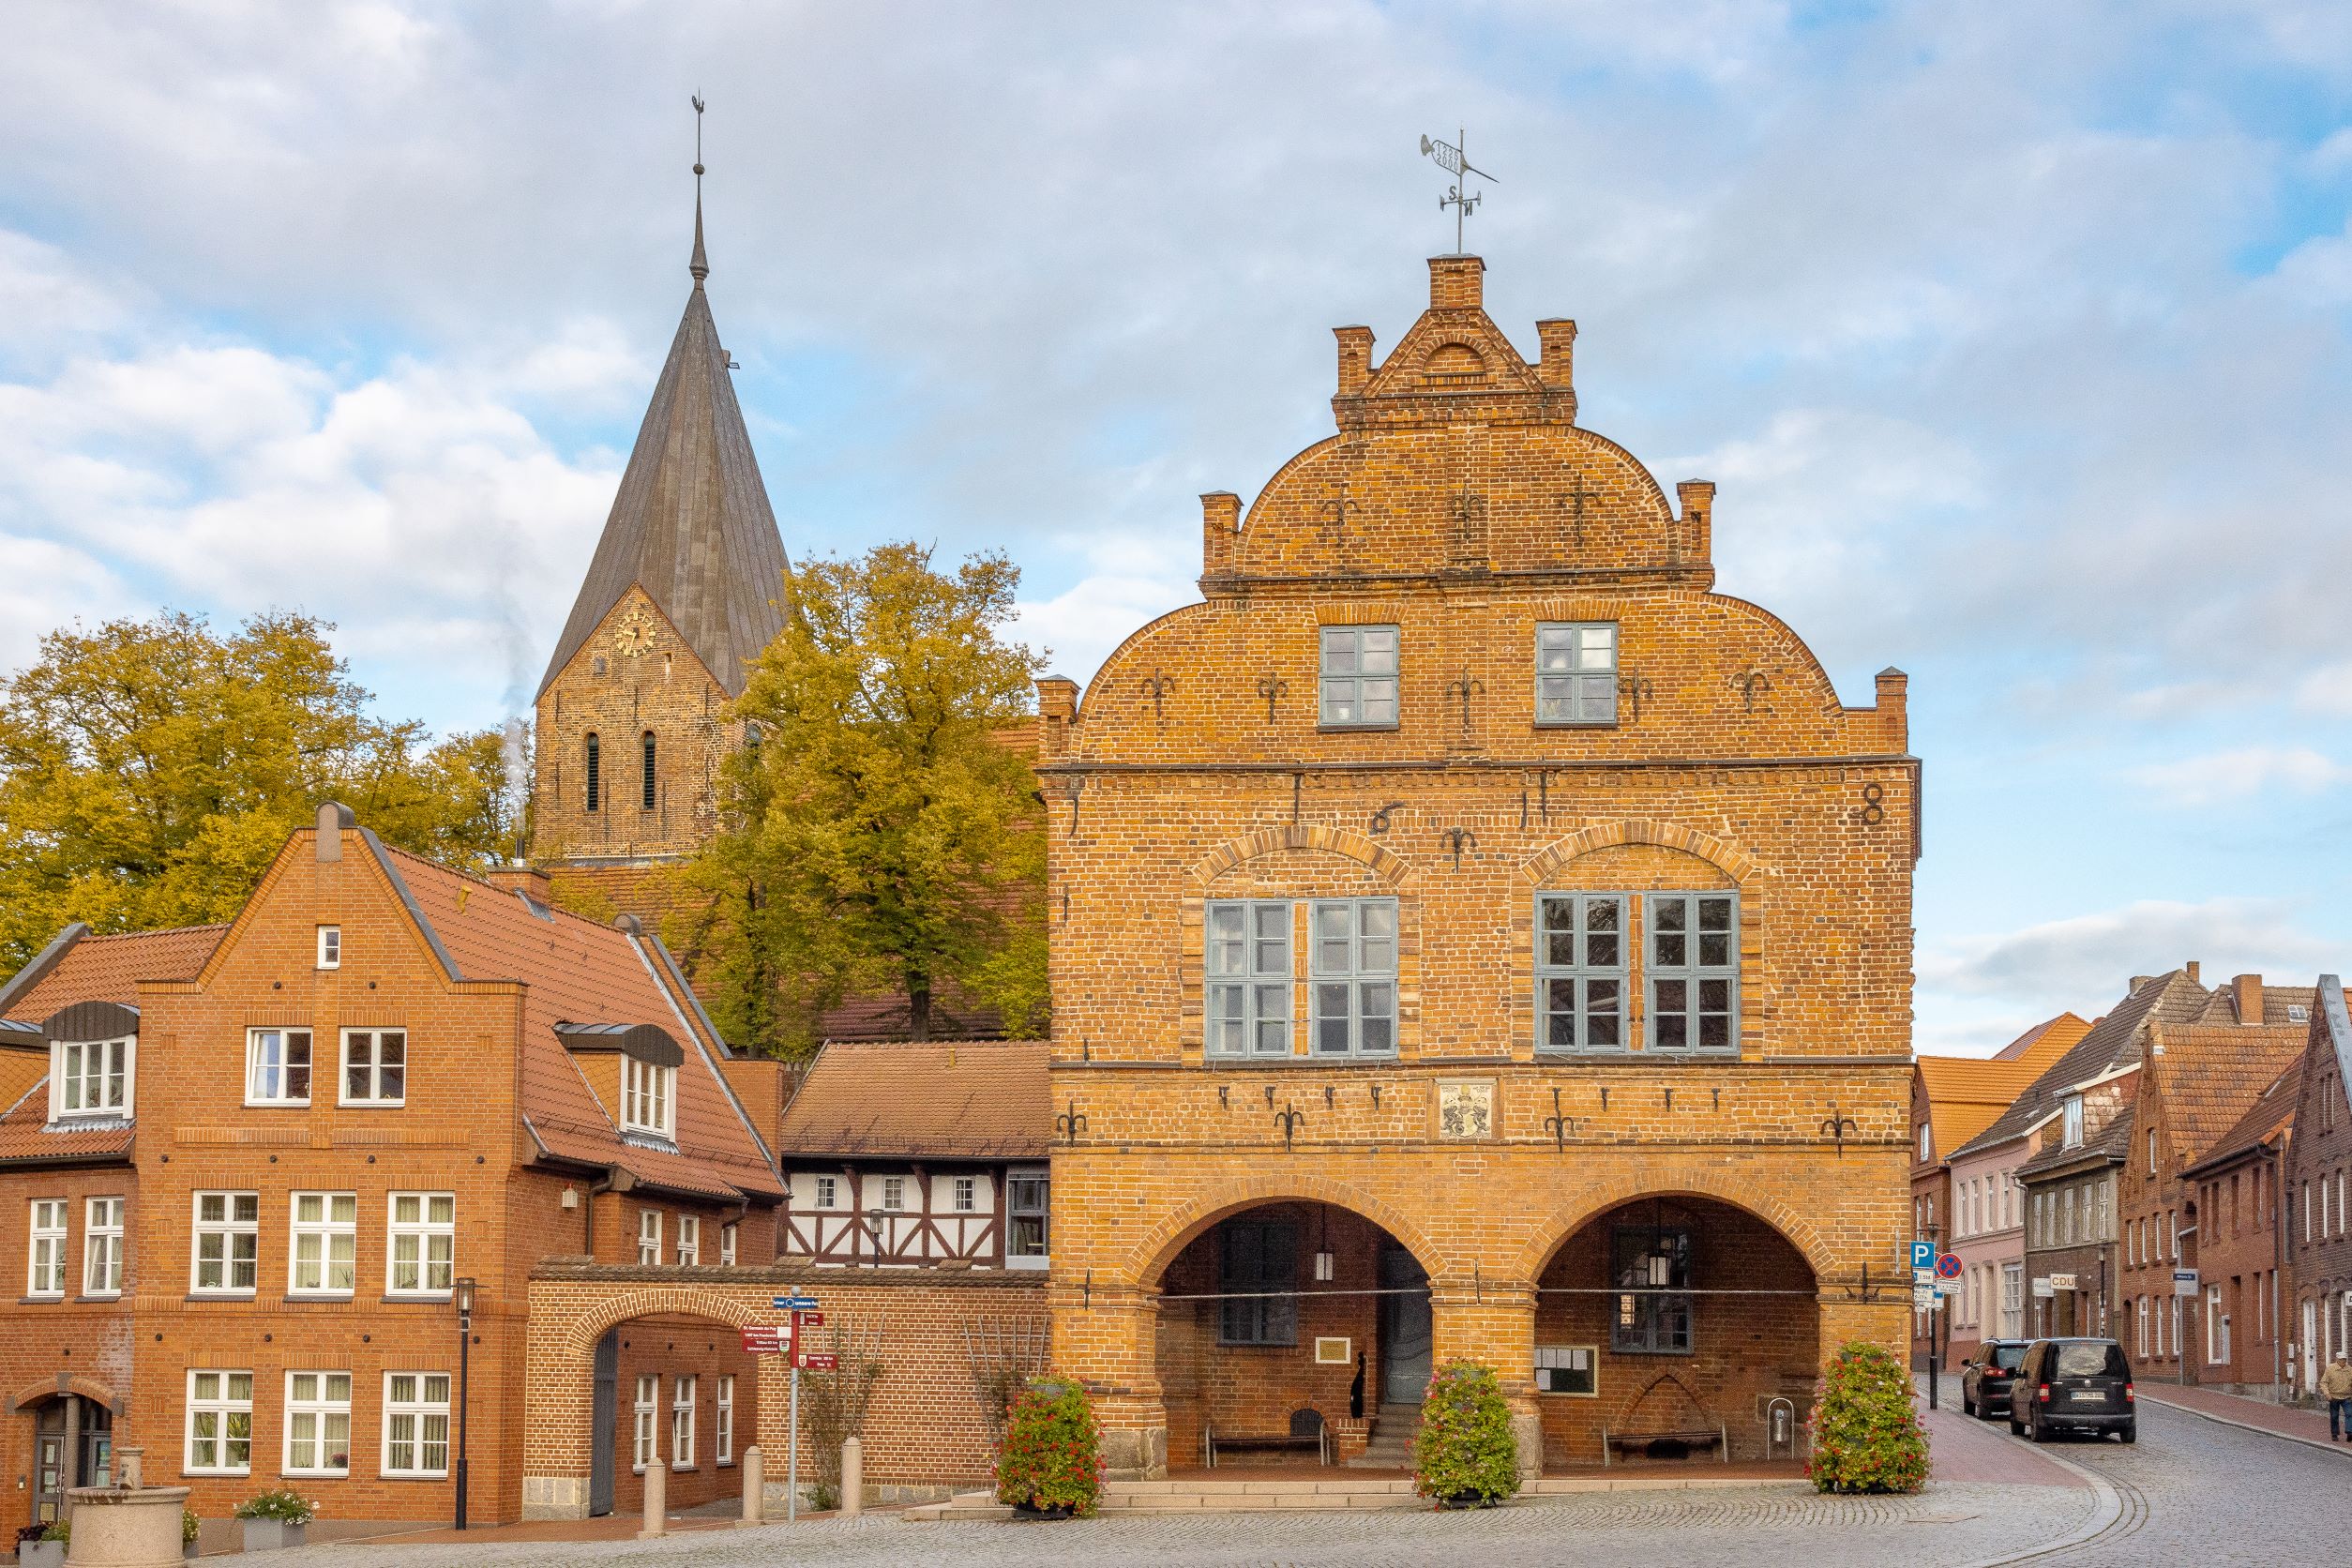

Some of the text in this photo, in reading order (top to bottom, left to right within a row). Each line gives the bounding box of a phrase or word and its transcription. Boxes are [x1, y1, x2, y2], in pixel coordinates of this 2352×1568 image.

[1437, 154, 1458, 173] 2000
[1449, 186, 1456, 201] S
[1371, 802, 1405, 833] 6
[1863, 783, 1884, 825] 8
[1915, 1244, 1929, 1264] P
[2052, 1277, 2074, 1286] CDU
